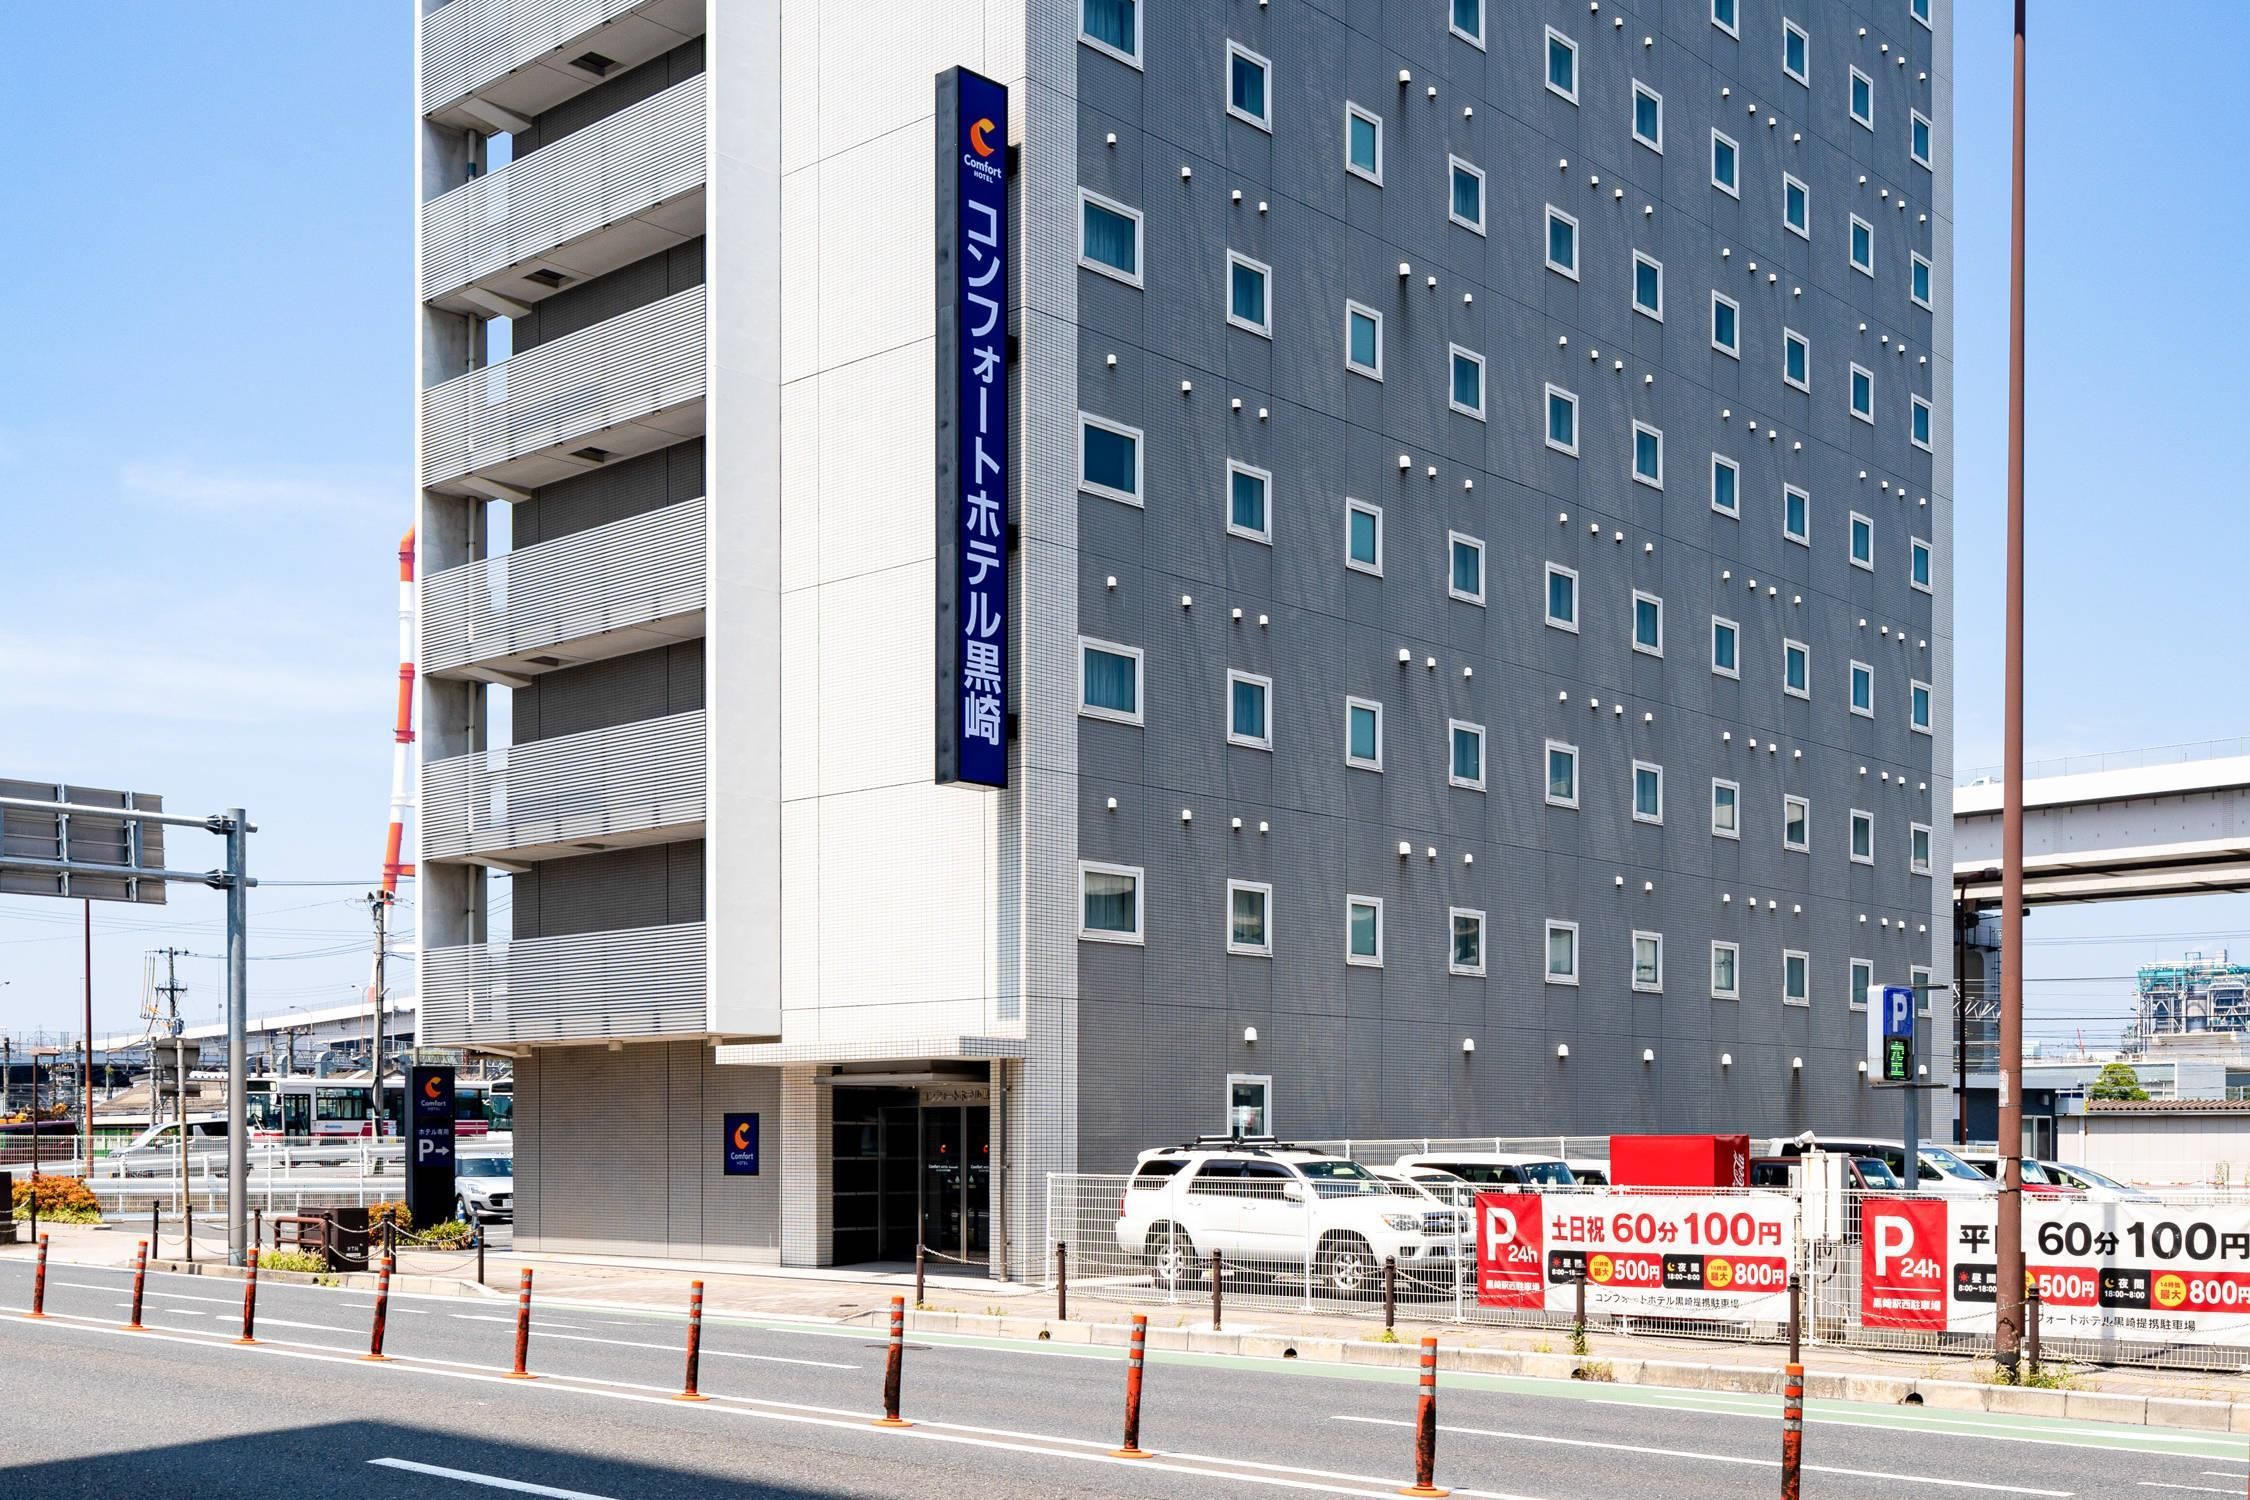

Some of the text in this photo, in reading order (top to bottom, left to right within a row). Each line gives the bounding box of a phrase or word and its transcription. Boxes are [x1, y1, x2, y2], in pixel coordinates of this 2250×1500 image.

[964, 154, 1002, 179] Comfort
[973, 170, 994, 184] HOTEL
[964, 199, 1001, 746] コンフォートホテル黒崎
[1893, 993, 1908, 1033] P
[419, 1139, 434, 1162] P
[730, 1151, 754, 1160] Comfort
[1486, 1207, 1517, 1261] P
[1552, 1212, 1782, 1246] 土日祝 60分 100円
[1959, 1221, 2249, 1261] 平 60分 100円
[1507, 1245, 1538, 1263] 24h
[1874, 1215, 1915, 1277] P
[1614, 1259, 1660, 1282] 500円
[1734, 1262, 1784, 1286] 800円
[1900, 1257, 1941, 1279] 24h
[2038, 1274, 2095, 1299] 500円
[2118, 1278, 2145, 1290] 夜間
[2160, 1289, 2182, 1301] 最大
[2189, 1279, 2250, 1306] 800円
[1872, 1297, 1942, 1312] 黒崎駅西駐車場
